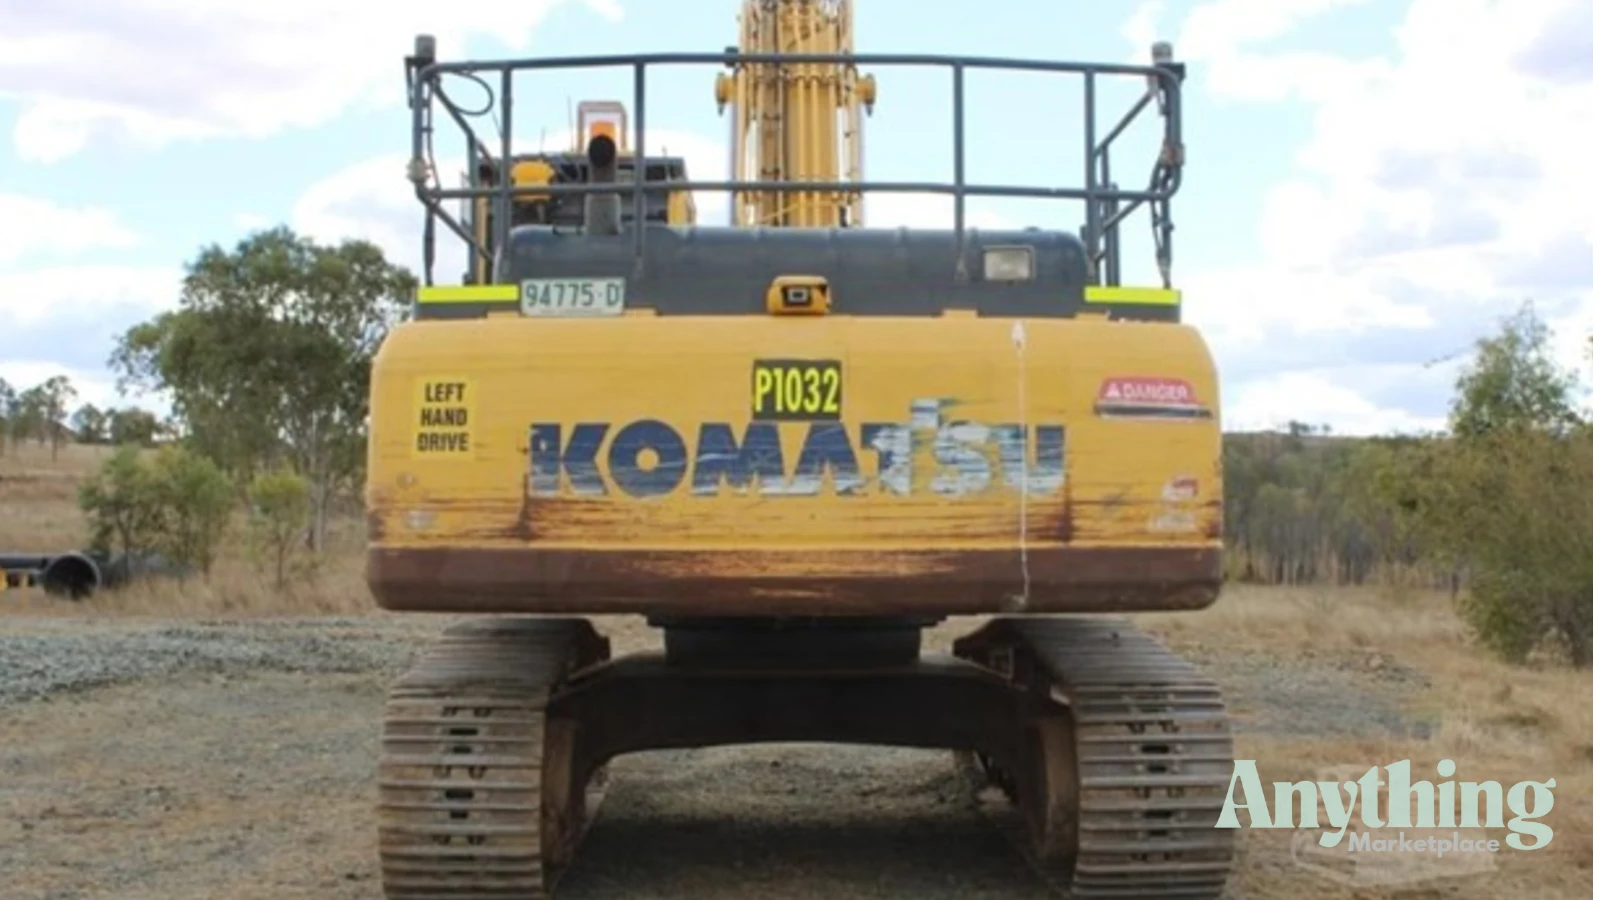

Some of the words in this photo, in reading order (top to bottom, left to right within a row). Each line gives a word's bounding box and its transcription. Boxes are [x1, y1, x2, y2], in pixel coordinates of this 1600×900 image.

[425, 382, 467, 403] LEFT
[755, 367, 839, 413] P1032
[420, 407, 468, 427] HAND
[416, 432, 470, 453] DRIVE
[529, 419, 1066, 498] KOMATSU
